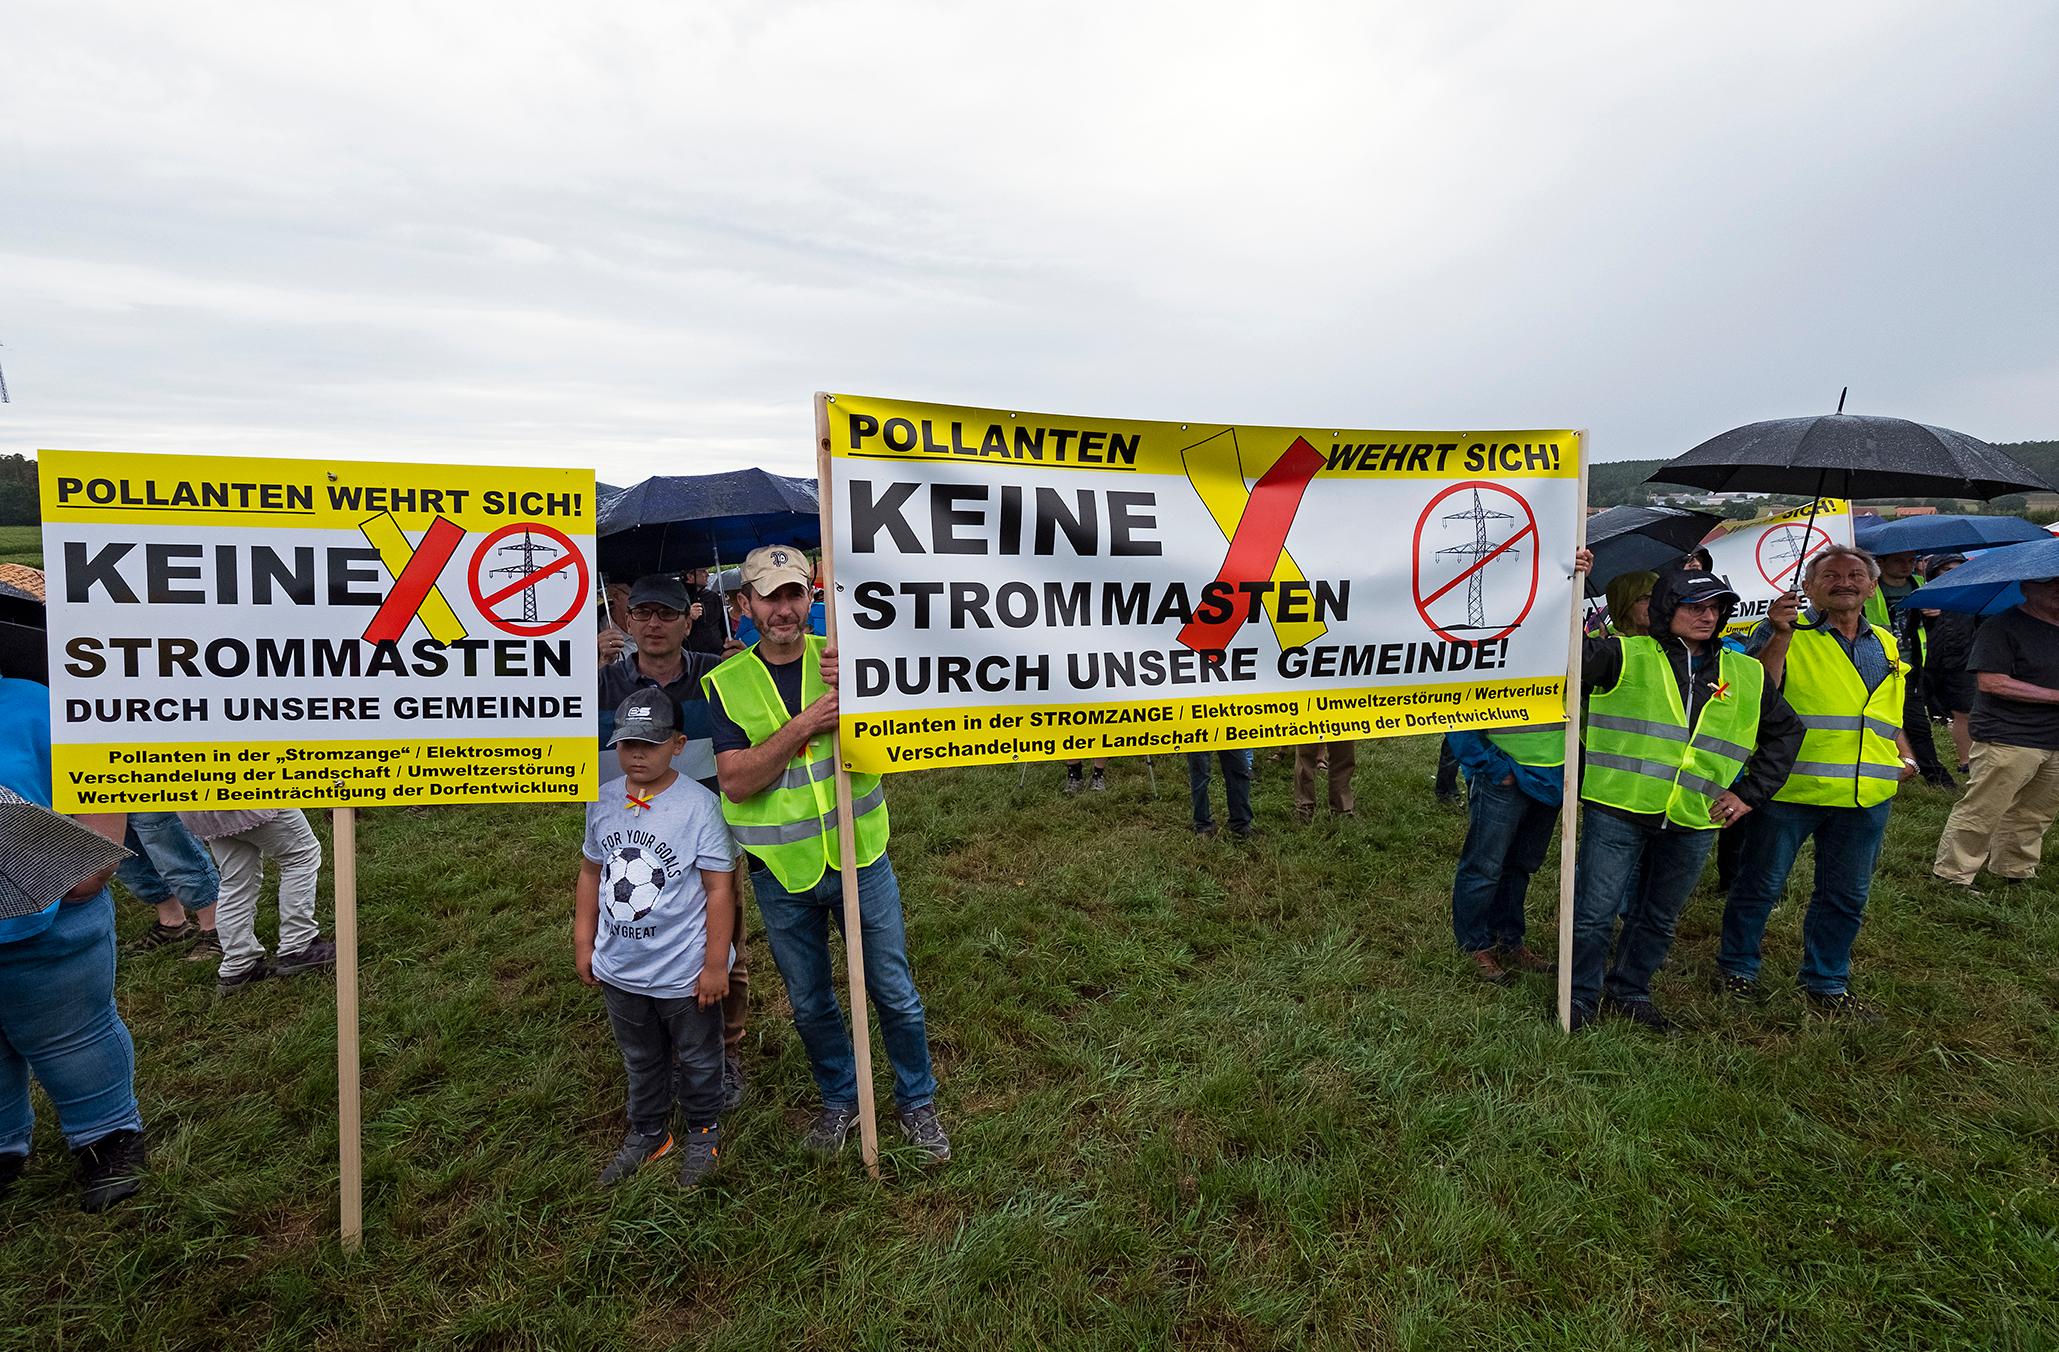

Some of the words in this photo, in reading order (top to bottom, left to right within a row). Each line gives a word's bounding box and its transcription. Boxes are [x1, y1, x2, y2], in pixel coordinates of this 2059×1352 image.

[849, 414, 1141, 464] POLLANTEN
[1327, 443, 1456, 472] WEHRT
[1464, 443, 1559, 471] SICH!
[58, 478, 312, 509] POLLANTEN
[327, 486, 469, 513] WEHRT
[483, 491, 581, 516] SICH!
[850, 480, 1162, 556] KEINE
[64, 541, 383, 606] KEINE
[852, 581, 1350, 629] STROMMASTEN
[65, 638, 570, 677] STROMMASTEN
[856, 655, 1049, 697] DURCH
[1068, 648, 1258, 689] UNSERE
[1278, 639, 1507, 679] GEMEINDE!
[66, 698, 208, 720] DURCH
[224, 698, 380, 721] UNSERE
[394, 697, 582, 719] GEMEINDE
[855, 718, 955, 738] Pollanten
[964, 715, 981, 729] in
[990, 714, 1023, 728] der
[1030, 707, 1173, 726] STROMZANGE
[1192, 702, 1299, 723] Elektrosmog
[1317, 691, 1462, 712] Umweltzerstörung
[1476, 683, 1558, 699] Wertverlust
[110, 751, 205, 763] Pollanten
[214, 750, 230, 761] in
[238, 750, 270, 761] der
[276, 747, 410, 764] „Stromzange“
[427, 746, 541, 760] Elektrosmog
[887, 738, 1055, 762] Verschandelung
[1063, 736, 1095, 750] der
[1102, 729, 1208, 749] Landschaft
[1226, 719, 1371, 743] Beeinträchtigung
[1376, 716, 1400, 729] der
[1406, 708, 1530, 729] Dorfentwicklung
[69, 770, 237, 785] Verschandelung
[244, 769, 275, 780] der
[282, 766, 391, 780] Landschaft
[408, 763, 576, 778] Umweltzerstörung
[78, 790, 198, 803] Wertverlust
[217, 783, 386, 801] Beeinträchtigung
[393, 785, 423, 796] der
[430, 782, 579, 797] Dorfentwicklung
[601, 832, 622, 852] FOR
[626, 830, 655, 848] YOUR
[654, 842, 682, 878] GOALS
[621, 926, 657, 940] GREAT
